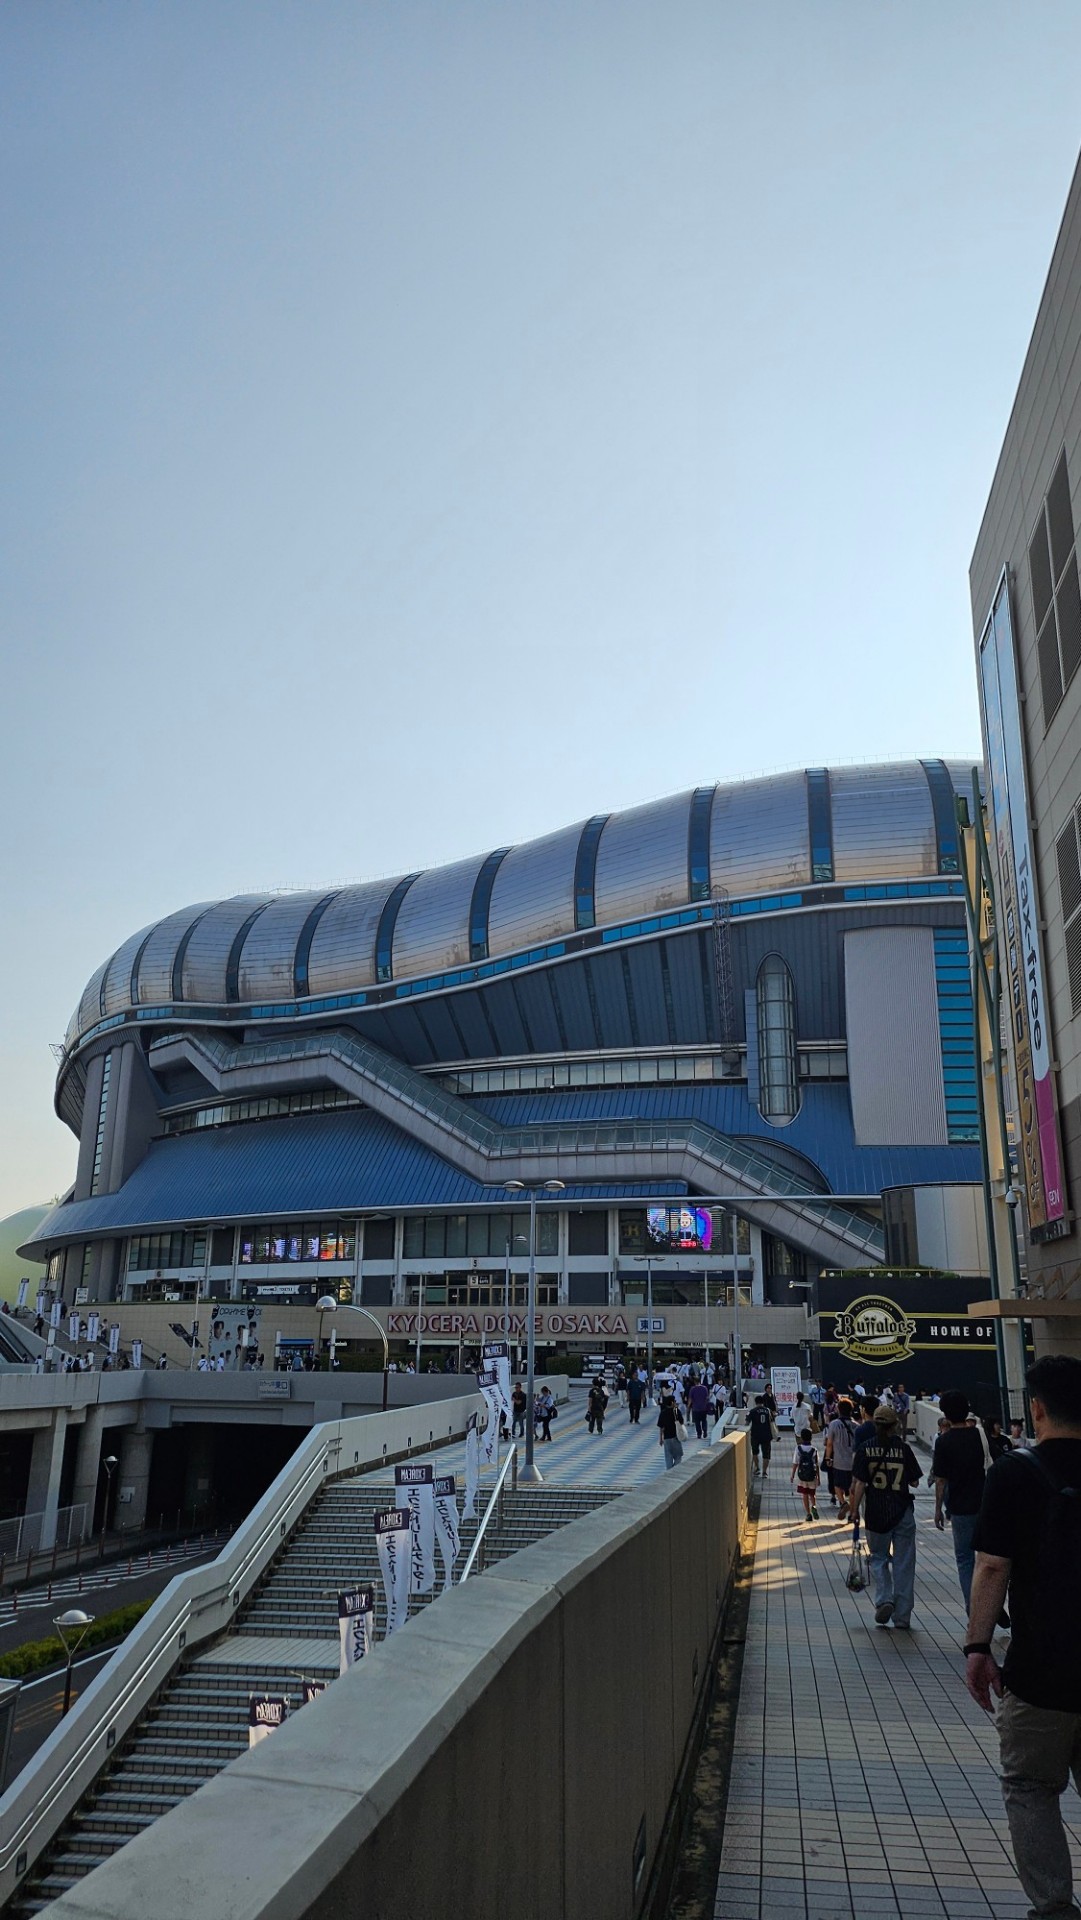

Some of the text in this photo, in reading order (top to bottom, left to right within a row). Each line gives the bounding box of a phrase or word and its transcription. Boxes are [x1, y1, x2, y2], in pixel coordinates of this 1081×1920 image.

[1018, 842, 1042, 1051] Tax-free
[387, 1314, 628, 1334] KYOCERA DOME OSAKA
[640, 1320, 662, 1330] 東口
[834, 1312, 916, 1337] Buffaloes
[930, 1326, 993, 1337] HOME OF
[760, 1414, 766, 1424] 0
[868, 1462, 904, 1490] 67
